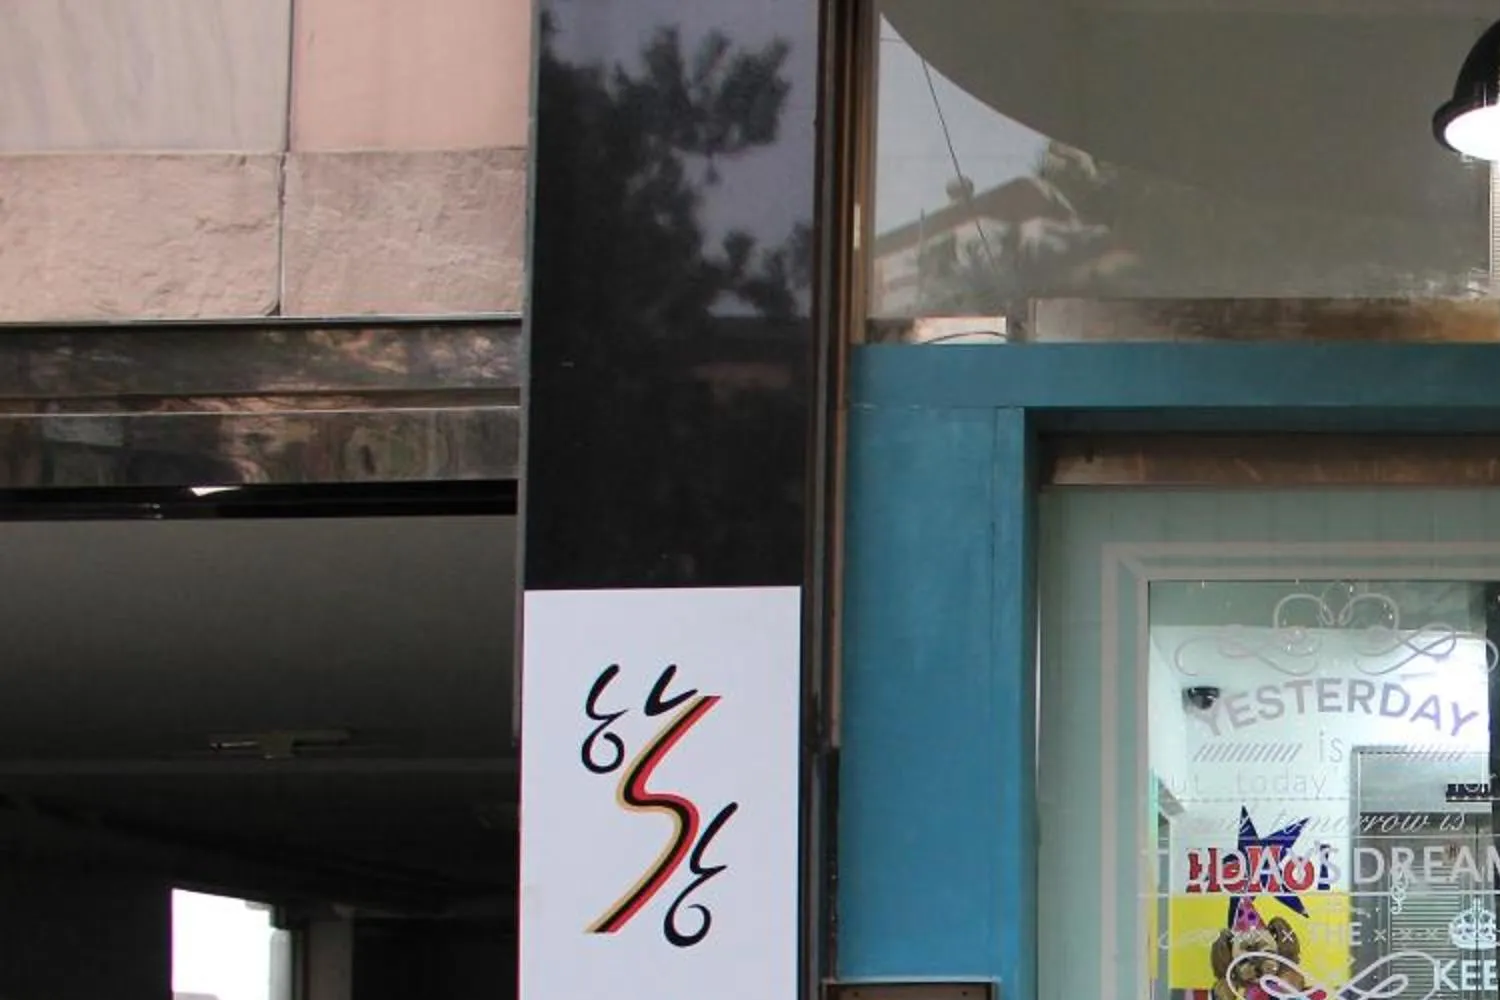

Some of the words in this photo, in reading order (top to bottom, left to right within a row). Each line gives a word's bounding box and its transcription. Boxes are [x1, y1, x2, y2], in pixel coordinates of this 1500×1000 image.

[1198, 676, 1480, 737] YESTERDAY
[1319, 731, 1344, 763] is
[1309, 921, 1362, 949] THE
